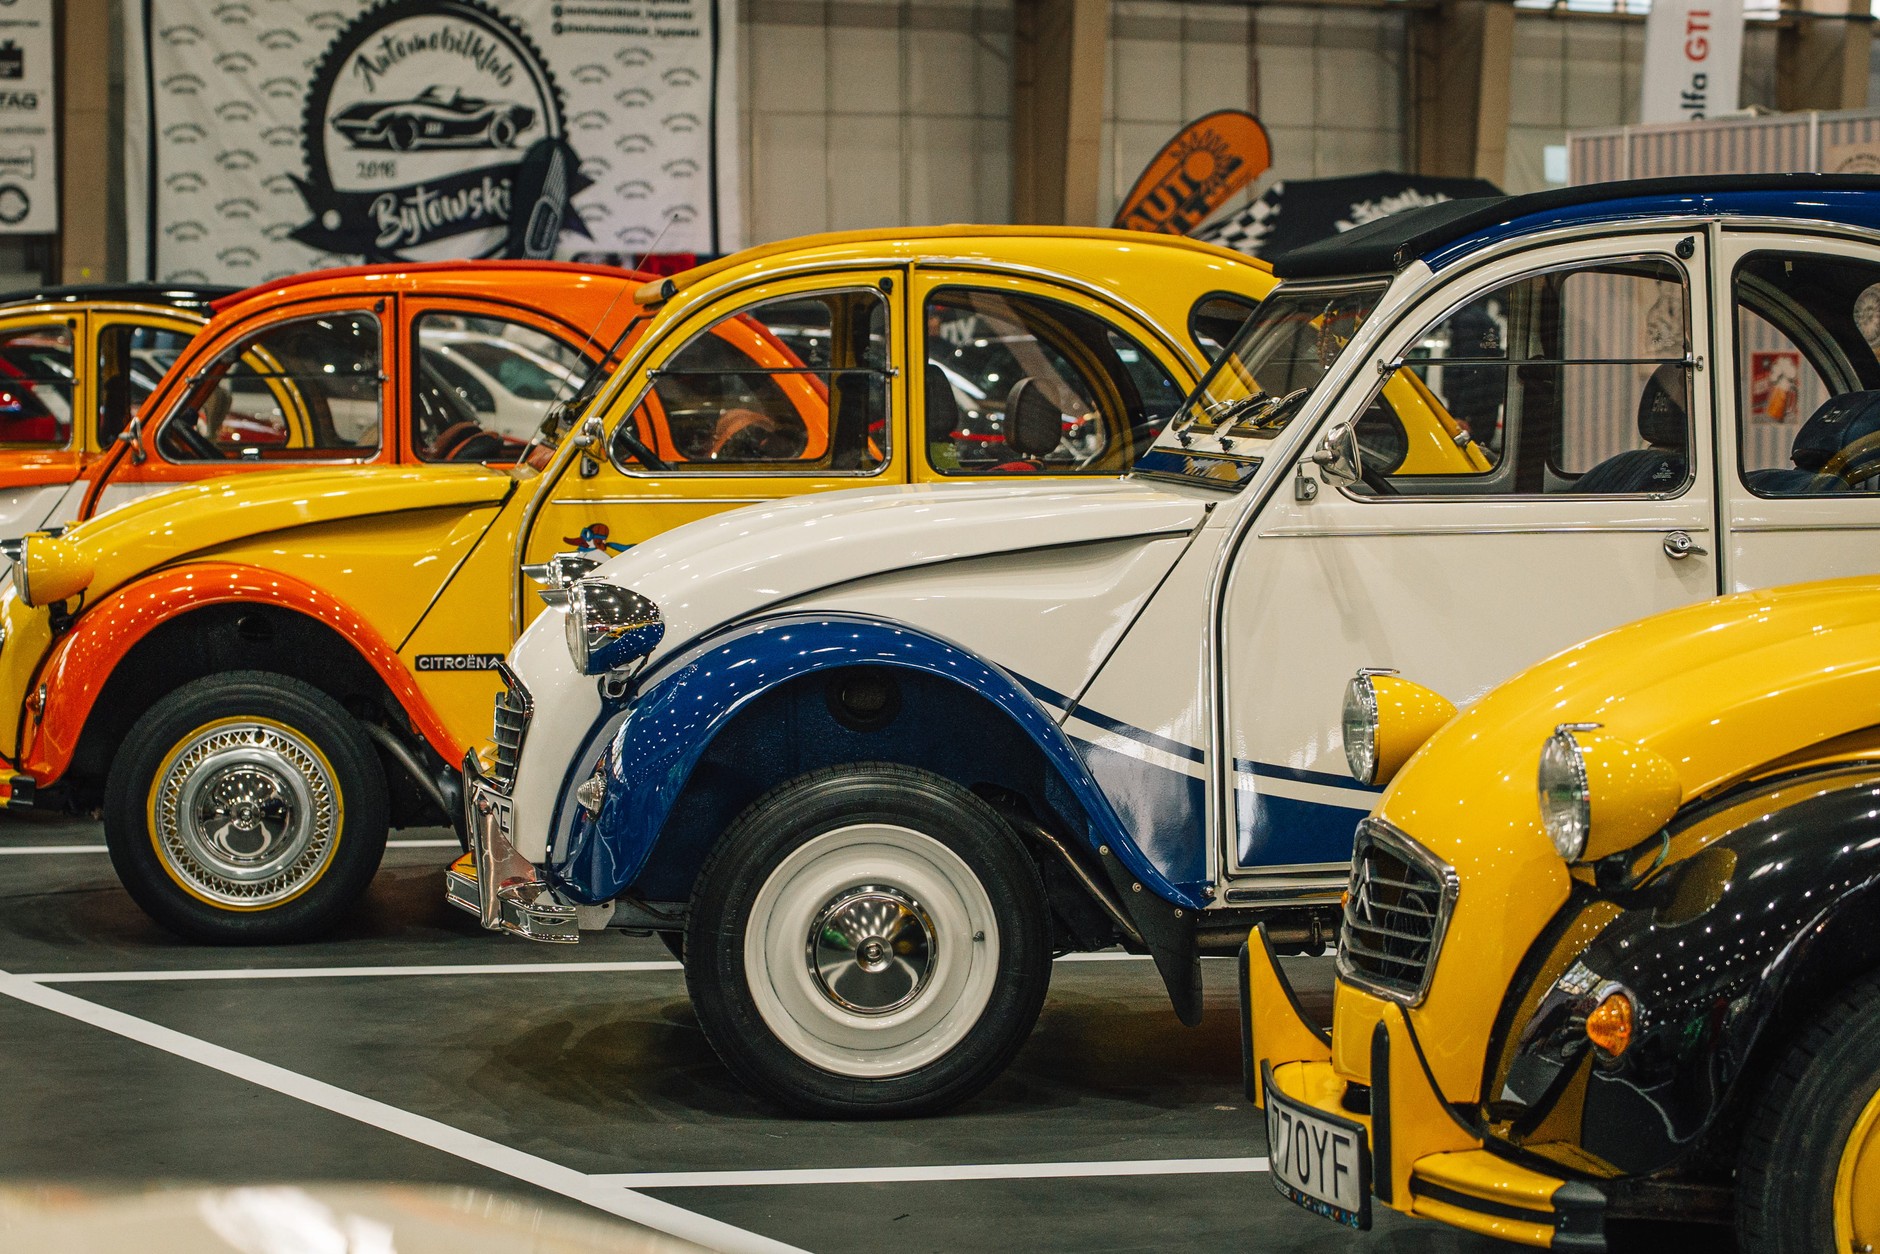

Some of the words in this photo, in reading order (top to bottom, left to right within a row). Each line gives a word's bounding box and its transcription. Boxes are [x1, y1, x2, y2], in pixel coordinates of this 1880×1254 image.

[353, 24, 514, 92] Automobilklub
[1684, 10, 1711, 62] GTI
[368, 176, 512, 249] Bytowski
[418, 654, 487, 669] CITROËN
